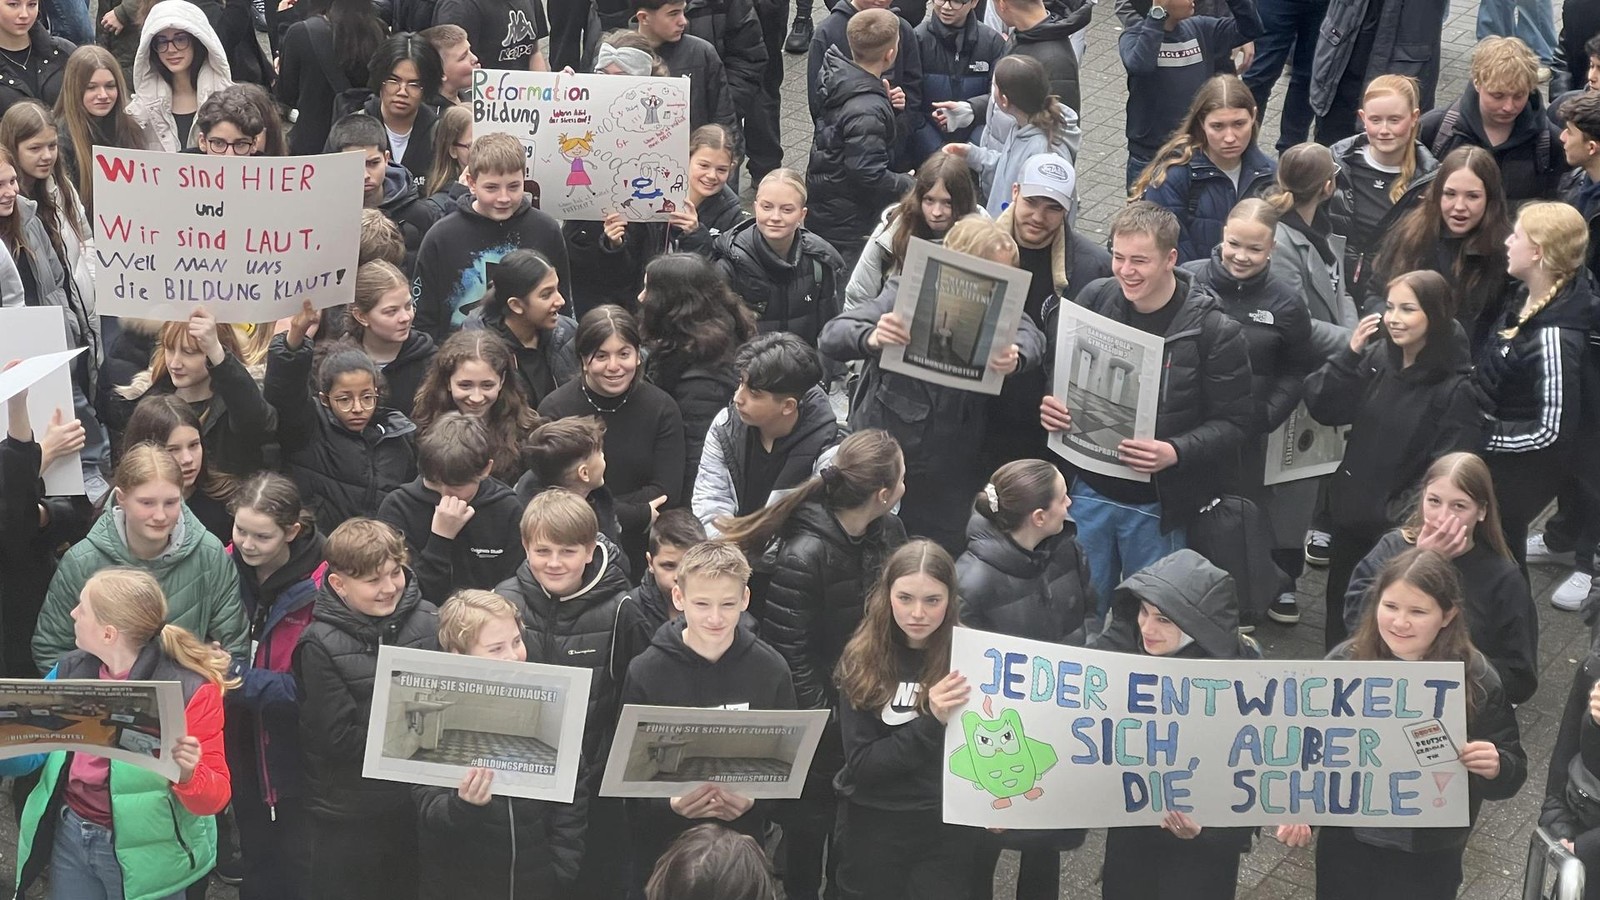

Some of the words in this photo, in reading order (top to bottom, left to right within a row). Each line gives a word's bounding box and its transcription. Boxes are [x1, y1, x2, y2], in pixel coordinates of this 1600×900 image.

[473, 70, 590, 101] Reformation
[473, 100, 540, 135] Bildung
[96, 154, 161, 186] Wir
[178, 166, 224, 190] sind
[242, 164, 315, 192] HIER
[195, 201, 224, 217] und
[99, 214, 160, 245] Wir
[177, 226, 226, 251] sind
[96, 250, 156, 272] Weil
[174, 257, 228, 273] MAN
[246, 260, 282, 275] UNS
[114, 273, 149, 300] die
[165, 277, 261, 301] BILDUNG
[273, 268, 347, 300] KLAUT!
[400, 674, 438, 689] FÜHLEN
[439, 680, 456, 691] SIE
[458, 682, 483, 694] SICH
[485, 685, 507, 697] WIE
[507, 687, 557, 703] ZUHAUSE!
[980, 648, 1108, 711] JEDER
[1128, 672, 1460, 718] ENTWICKELT
[645, 724, 683, 734] FÜHLEN
[684, 725, 700, 734] SIE
[701, 726, 727, 735] SICH
[728, 726, 748, 735] WIE
[749, 726, 798, 736] ZUHAUSE!
[1071, 717, 1200, 771] SICH,
[1415, 735, 1447, 747] DEUTSCH
[470, 758, 555, 775] #BILDUNGSPROTEST
[708, 774, 788, 783] #BILDUNGSPROTEST
[1122, 770, 1194, 812] DIE
